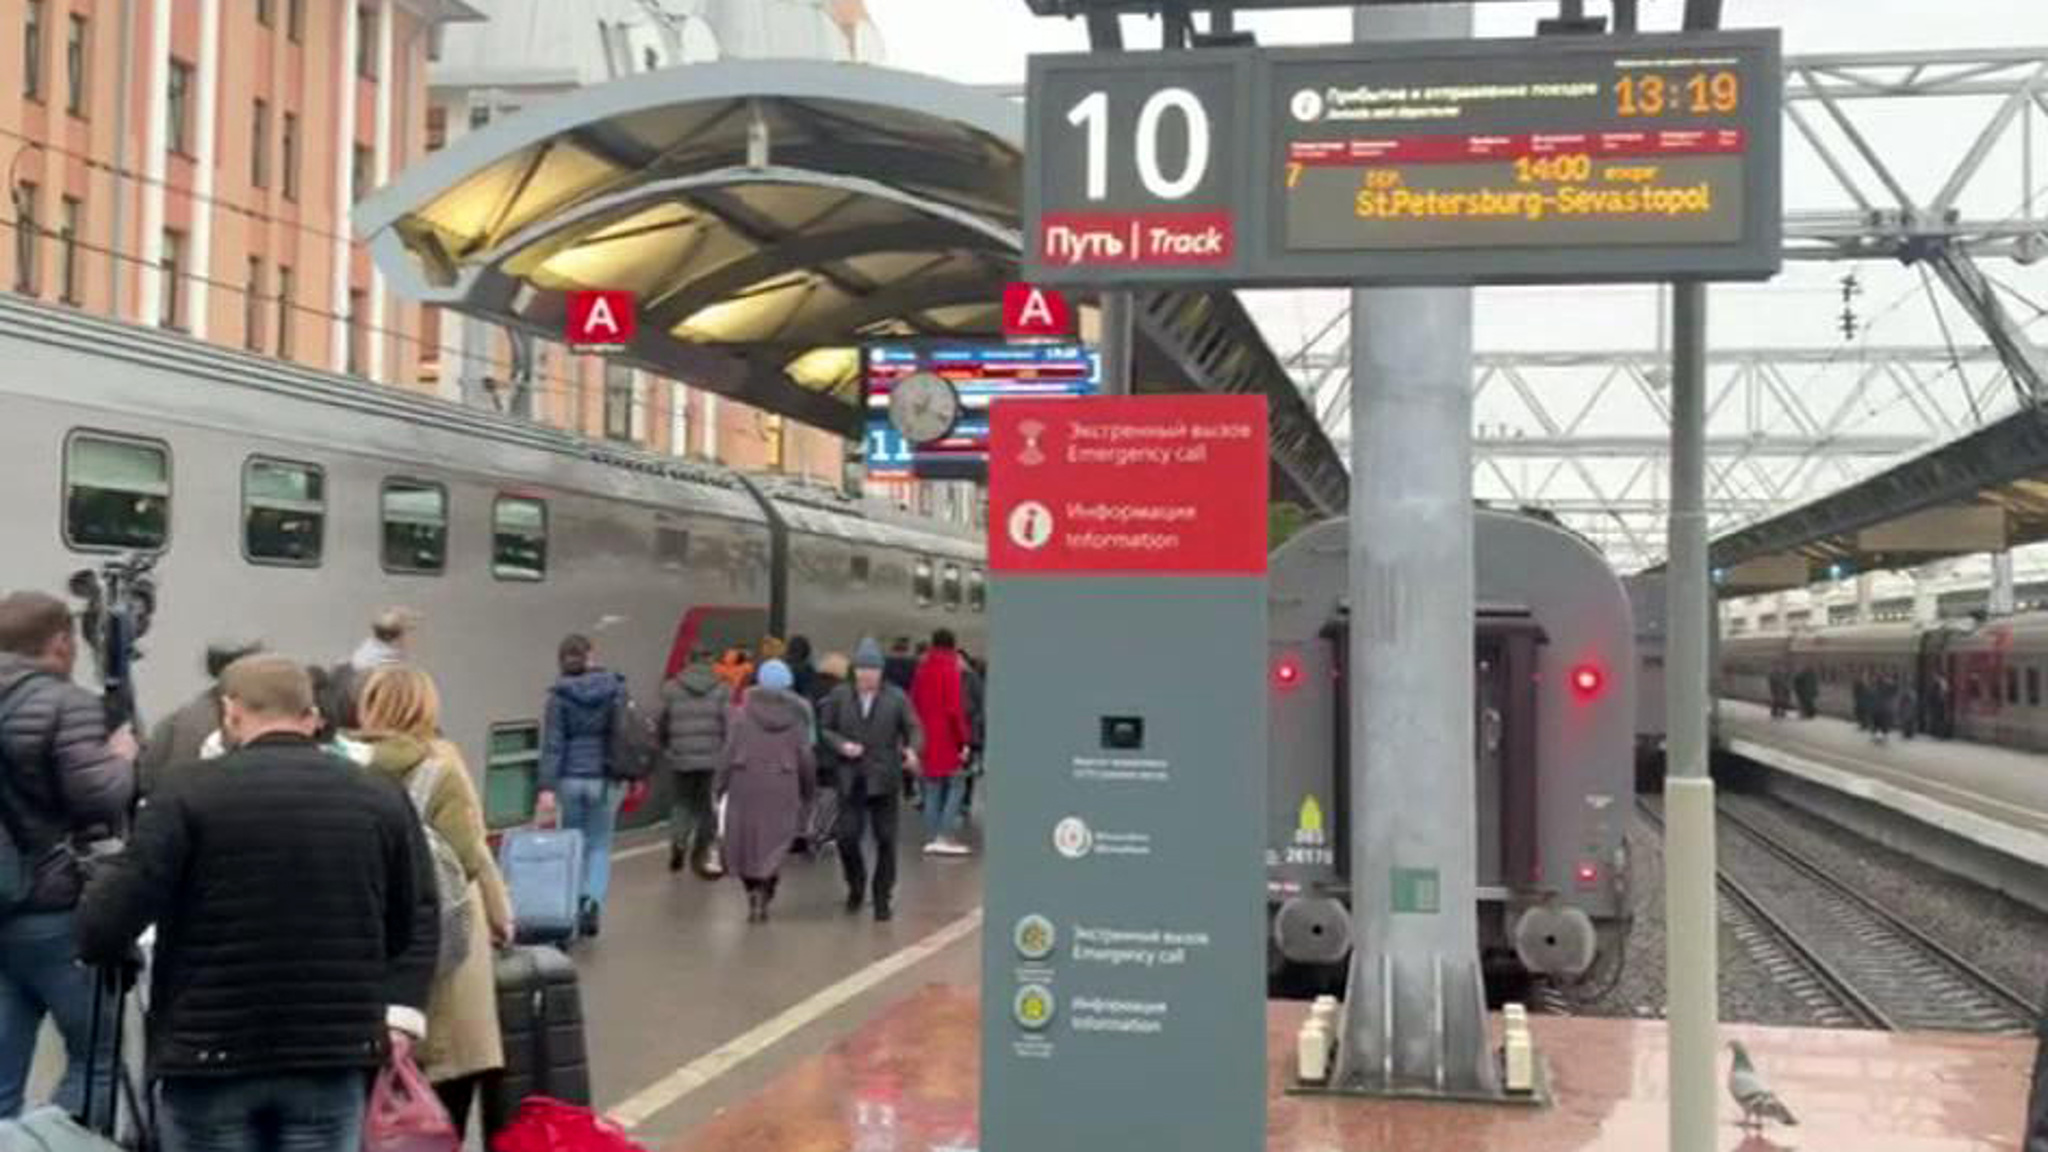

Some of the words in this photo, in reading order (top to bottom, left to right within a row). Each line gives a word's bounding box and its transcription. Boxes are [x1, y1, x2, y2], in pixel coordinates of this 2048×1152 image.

[1615, 70, 1737, 116] 13:19
[1067, 88, 1210, 200] 10
[1286, 162, 1302, 187] 7
[1514, 155, 1591, 182] 14:00
[1046, 225, 1124, 264] Путь
[1149, 225, 1223, 254] Track
[583, 296, 619, 333] A
[1018, 288, 1053, 325] A
[1068, 420, 1186, 441] Экстренный
[1191, 423, 1251, 438] вызов
[1066, 444, 1171, 466] Emergency
[1175, 444, 1207, 463] call
[1066, 501, 1196, 523] Информация
[1066, 531, 1179, 549] Information
[1073, 945, 1154, 966] Emergency
[1159, 948, 1185, 964] call
[1071, 1016, 1162, 1032] Information
